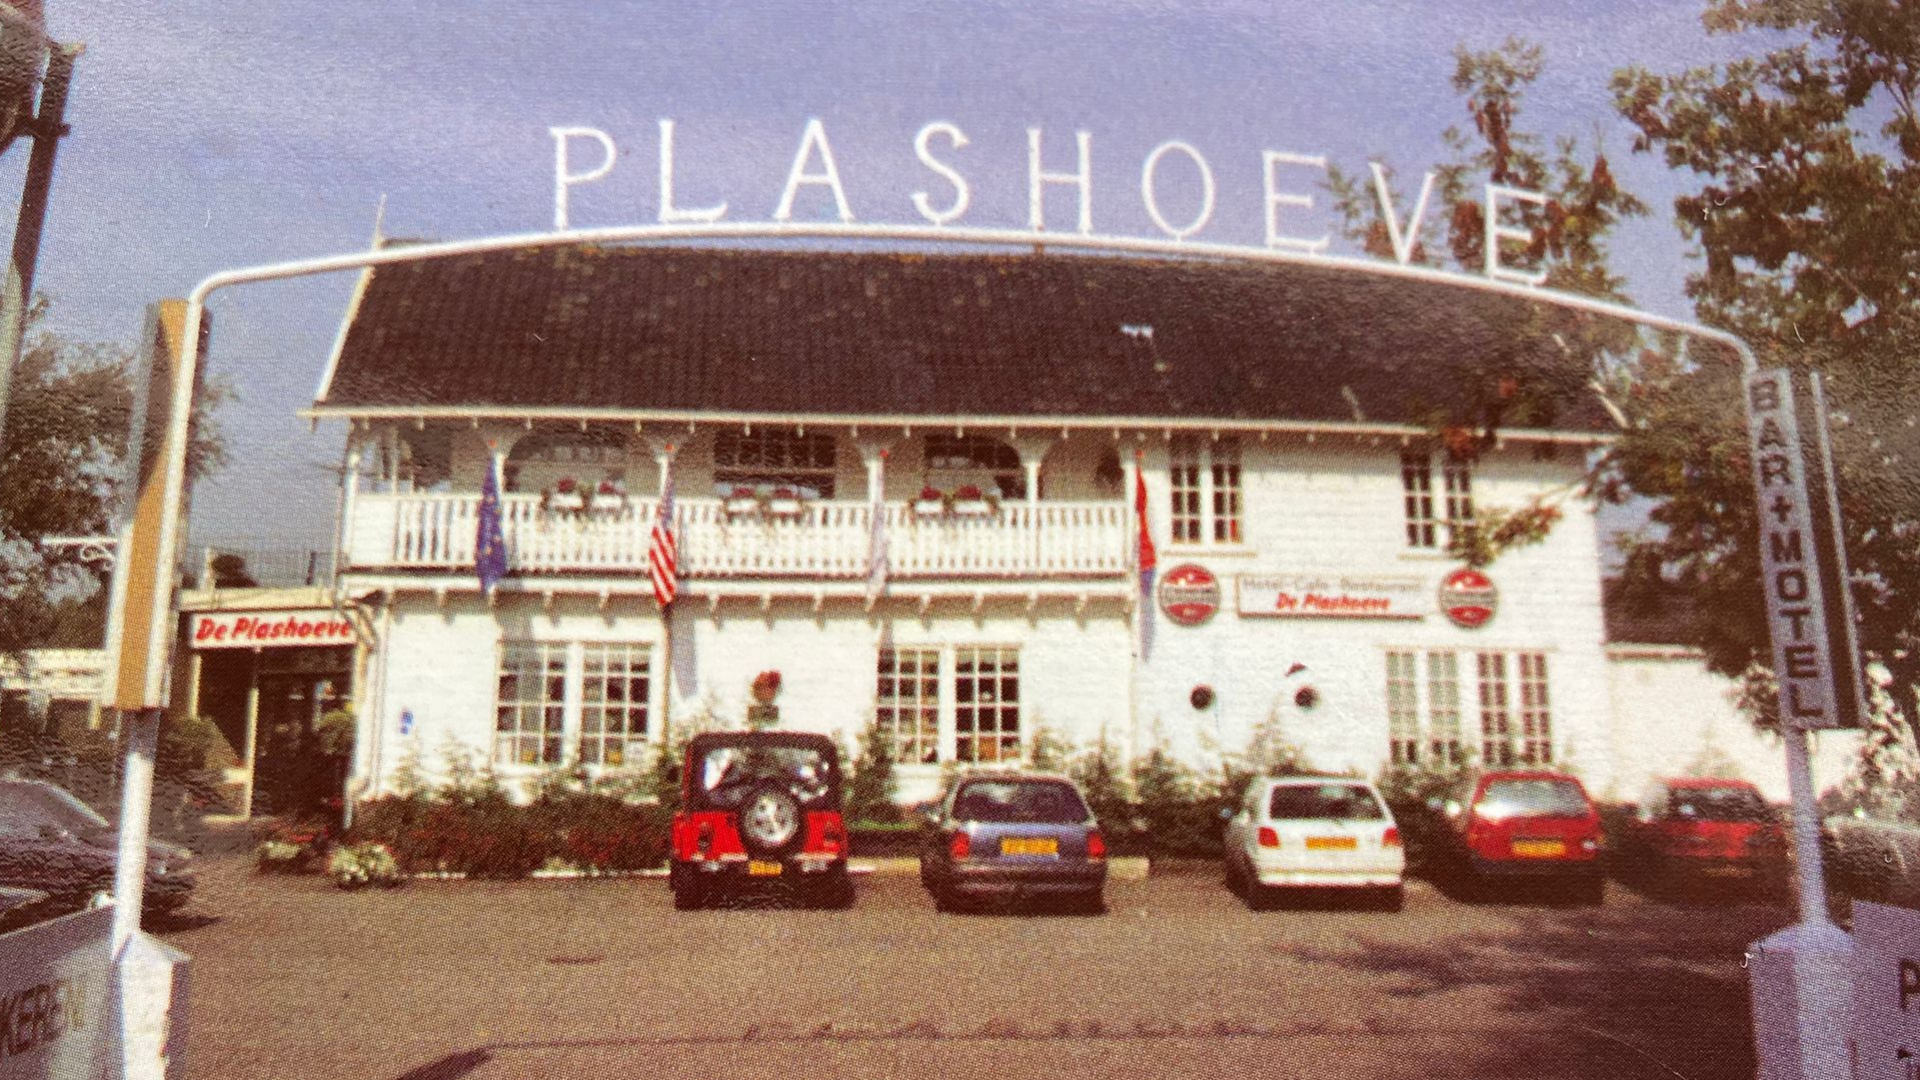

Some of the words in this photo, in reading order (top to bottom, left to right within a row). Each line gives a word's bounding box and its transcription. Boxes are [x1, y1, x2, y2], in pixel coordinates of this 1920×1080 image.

[549, 118, 1549, 287] PLASHOEVE
[1276, 592, 1297, 609] De
[1302, 593, 1391, 610] Plashoeve
[195, 618, 228, 641] De
[231, 616, 351, 640] Plashoeve
